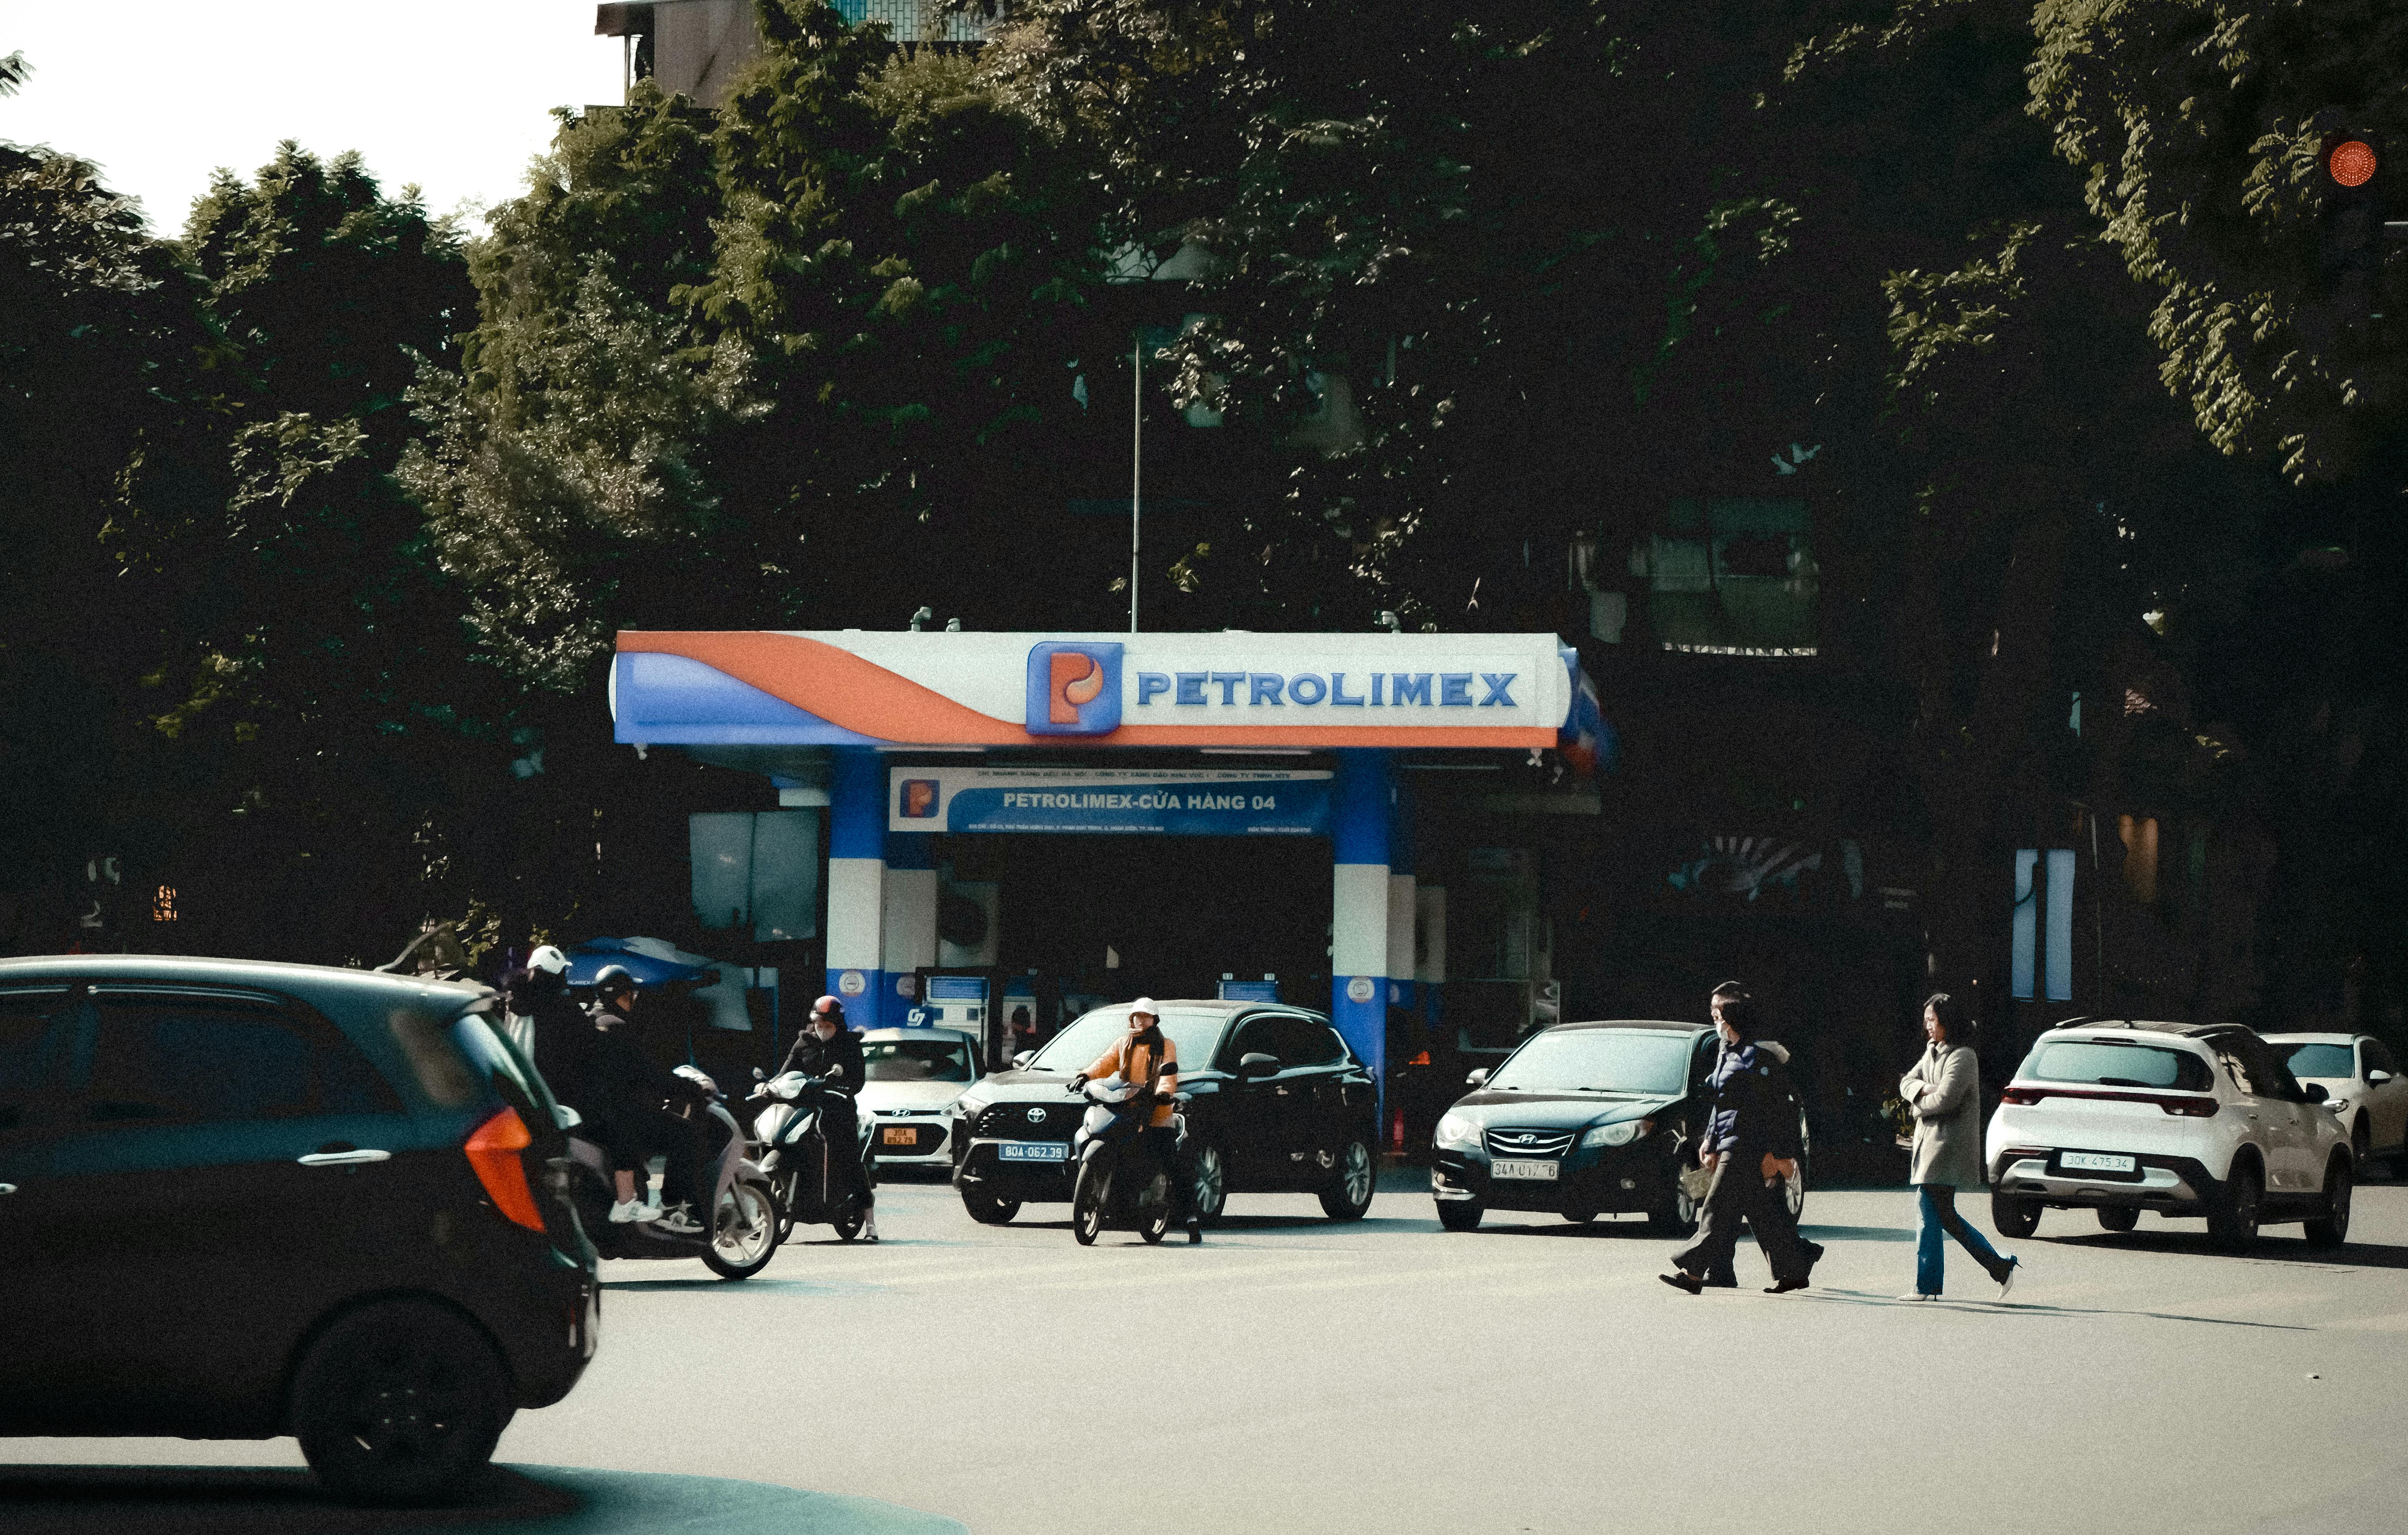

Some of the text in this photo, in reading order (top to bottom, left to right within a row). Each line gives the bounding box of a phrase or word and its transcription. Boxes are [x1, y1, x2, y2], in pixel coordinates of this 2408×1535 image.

[1137, 671, 1518, 706] PETROLIMEX
[1004, 790, 1276, 810] PETROLIMEX-CỬA HÀNG 04
[907, 1008, 926, 1026] G7
